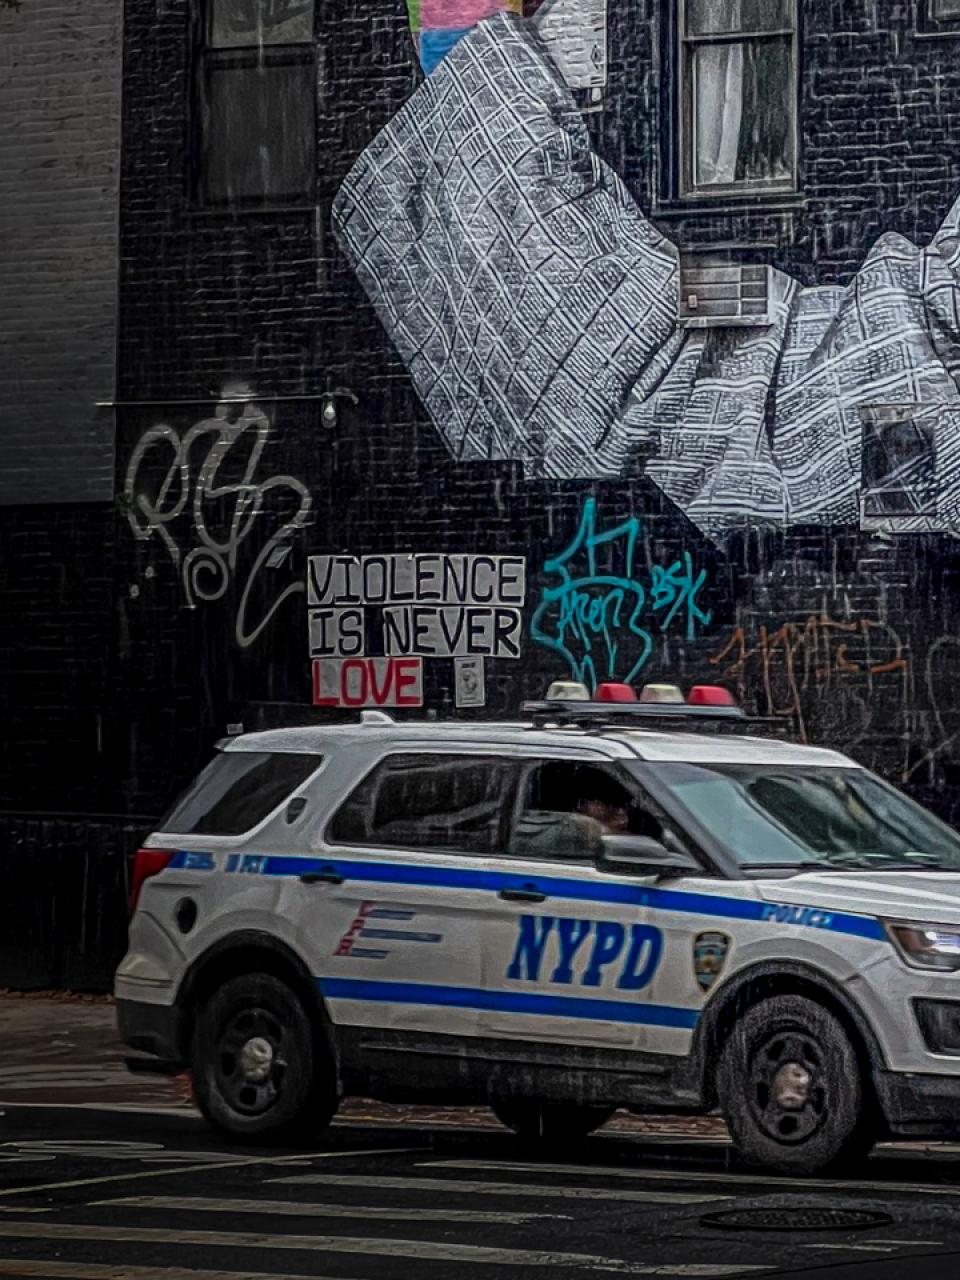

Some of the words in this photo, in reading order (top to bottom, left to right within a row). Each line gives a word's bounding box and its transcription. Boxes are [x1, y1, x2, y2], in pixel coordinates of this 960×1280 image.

[309, 555, 524, 603] VIOLENCE
[311, 610, 363, 656] IS
[384, 606, 521, 656] NEVER
[313, 657, 422, 706] LOVE
[506, 914, 665, 990] NYPD
